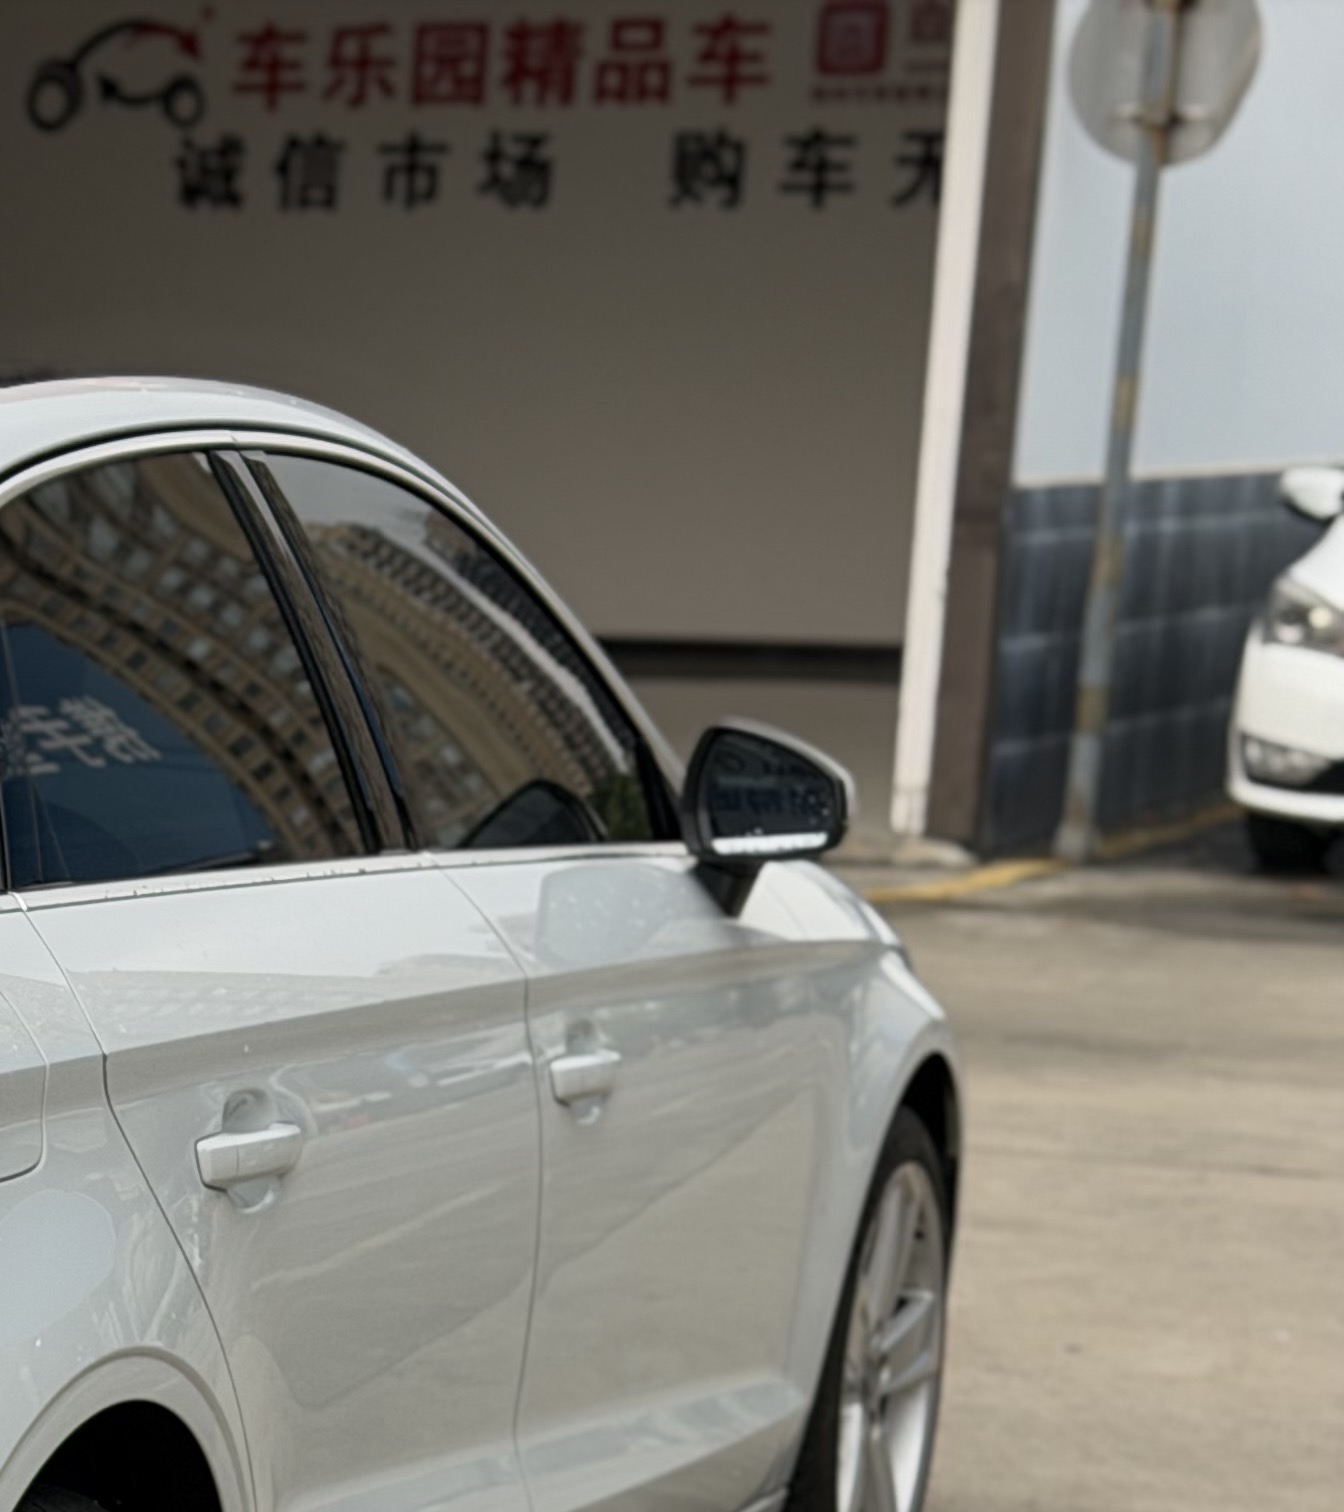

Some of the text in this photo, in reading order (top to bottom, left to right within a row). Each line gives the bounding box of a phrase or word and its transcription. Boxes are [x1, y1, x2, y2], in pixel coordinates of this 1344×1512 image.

[231, 14, 772, 113] 车乐园精品车
[174, 130, 555, 211] 诚信市场
